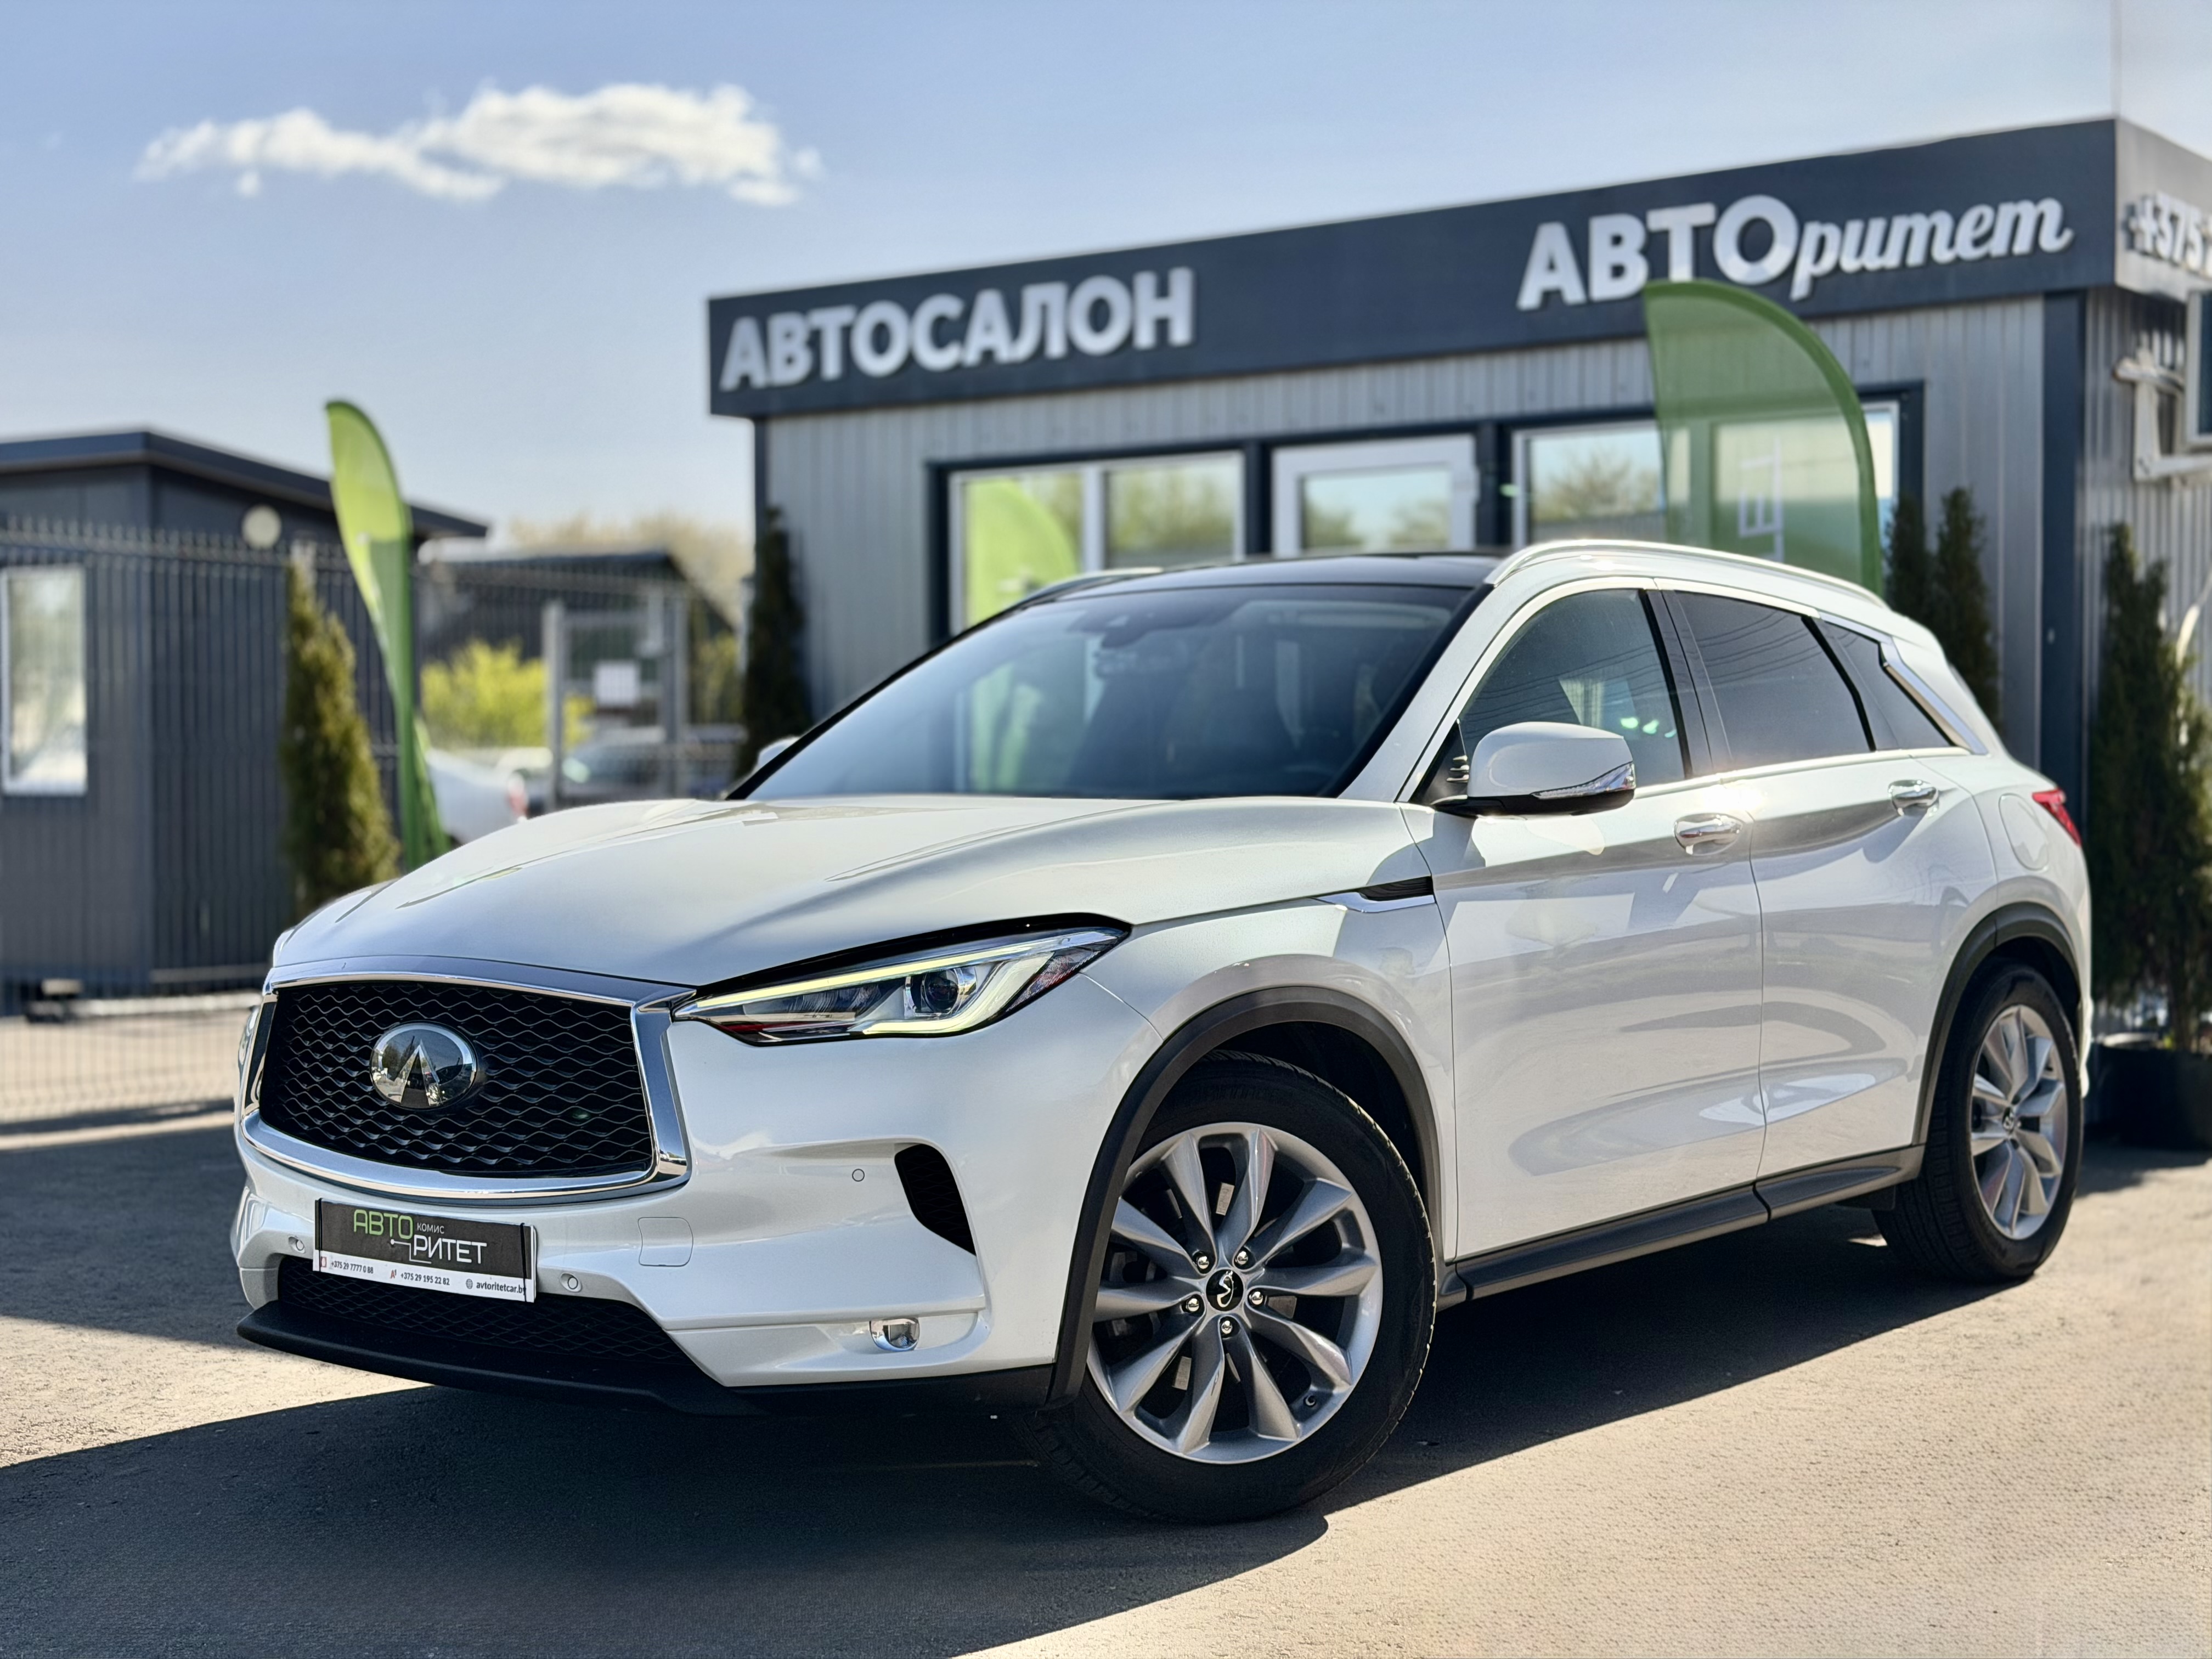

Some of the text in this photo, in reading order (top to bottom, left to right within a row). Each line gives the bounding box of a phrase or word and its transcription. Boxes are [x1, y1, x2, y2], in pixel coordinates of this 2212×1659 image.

[719, 267, 1193, 392] АВТОСАЛОН
[354, 1209, 413, 1239] АВТО
[417, 1222, 445, 1234] КОМИС
[414, 1234, 487, 1264] РИТЕТ
[331, 1260, 343, 1269] +375
[343, 1262, 349, 1270] 29
[400, 1272, 414, 1281] +375
[415, 1273, 422, 1282] 29
[423, 1275, 433, 1284] 195
[443, 1277, 450, 1286] 82
